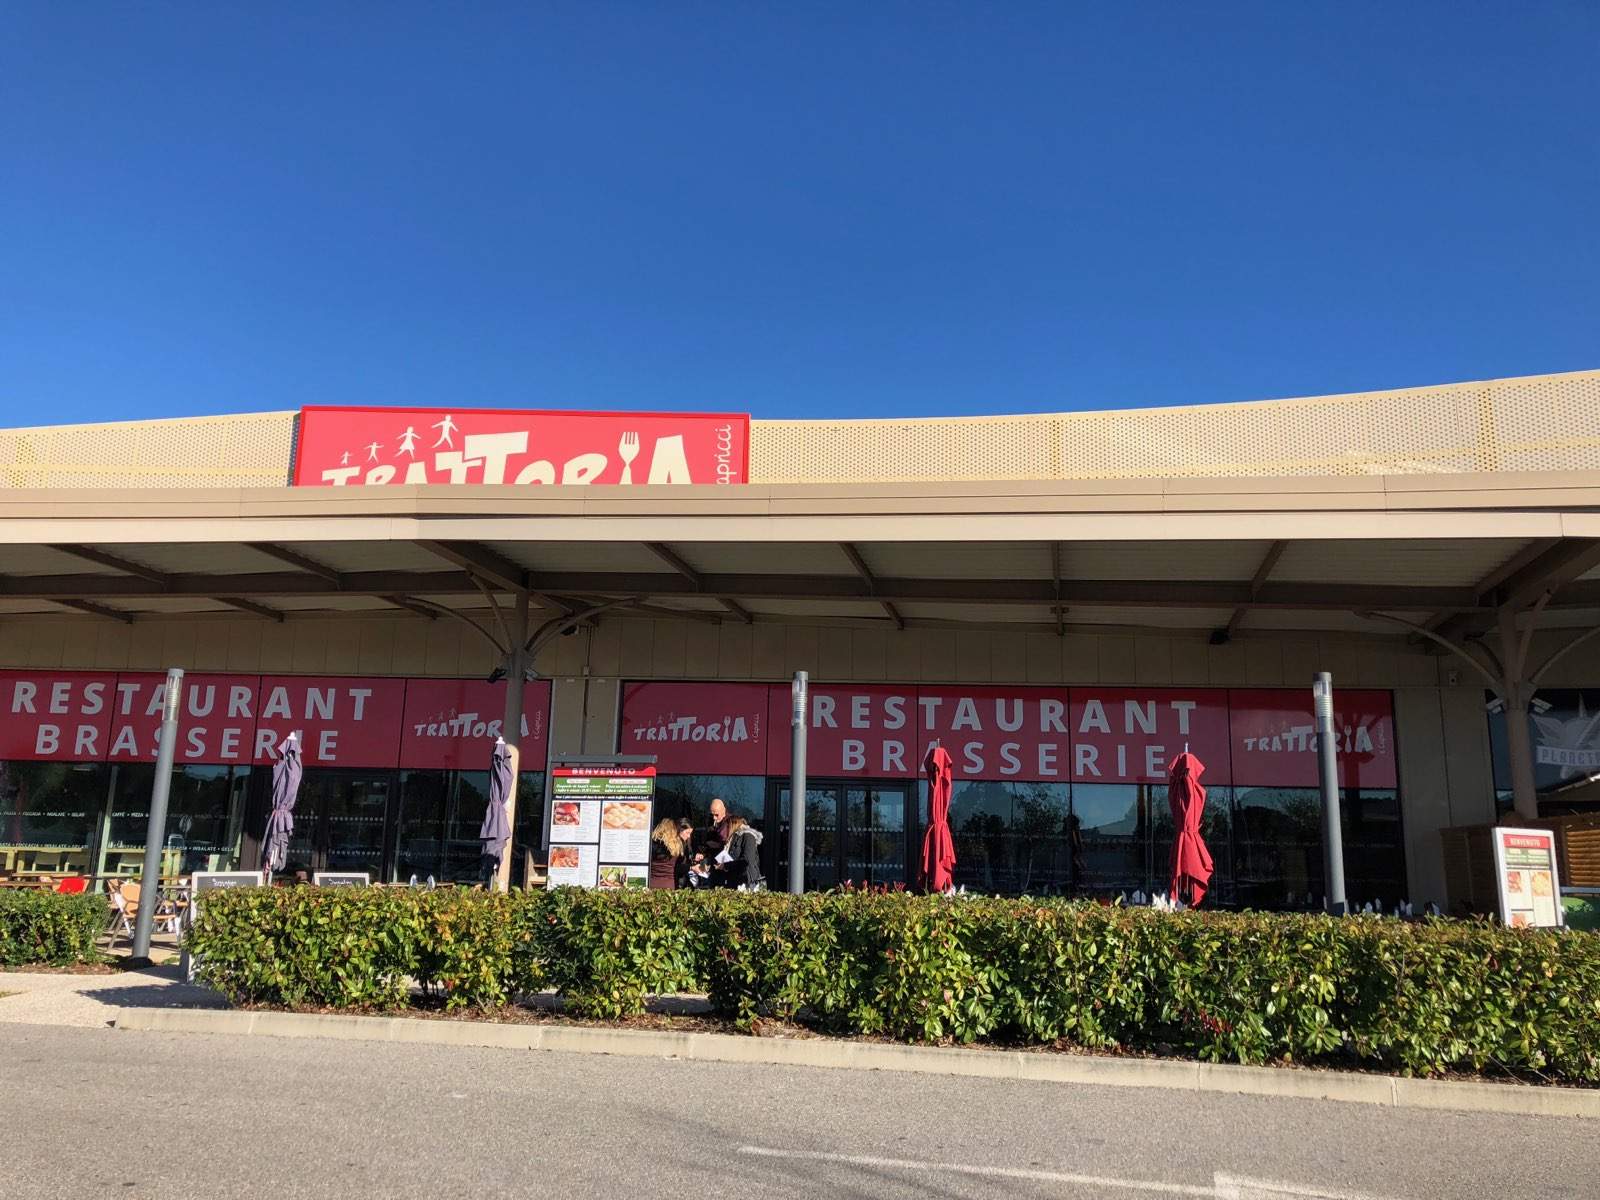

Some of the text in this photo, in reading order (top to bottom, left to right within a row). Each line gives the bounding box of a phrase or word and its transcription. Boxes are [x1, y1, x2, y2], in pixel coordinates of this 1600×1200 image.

[714, 424, 737, 484] apricci
[12, 681, 372, 721] RESTAURANT
[812, 695, 1196, 735] RESTAURANT
[414, 713, 529, 738] TRATTOR
[633, 716, 748, 742] TRATTORIA
